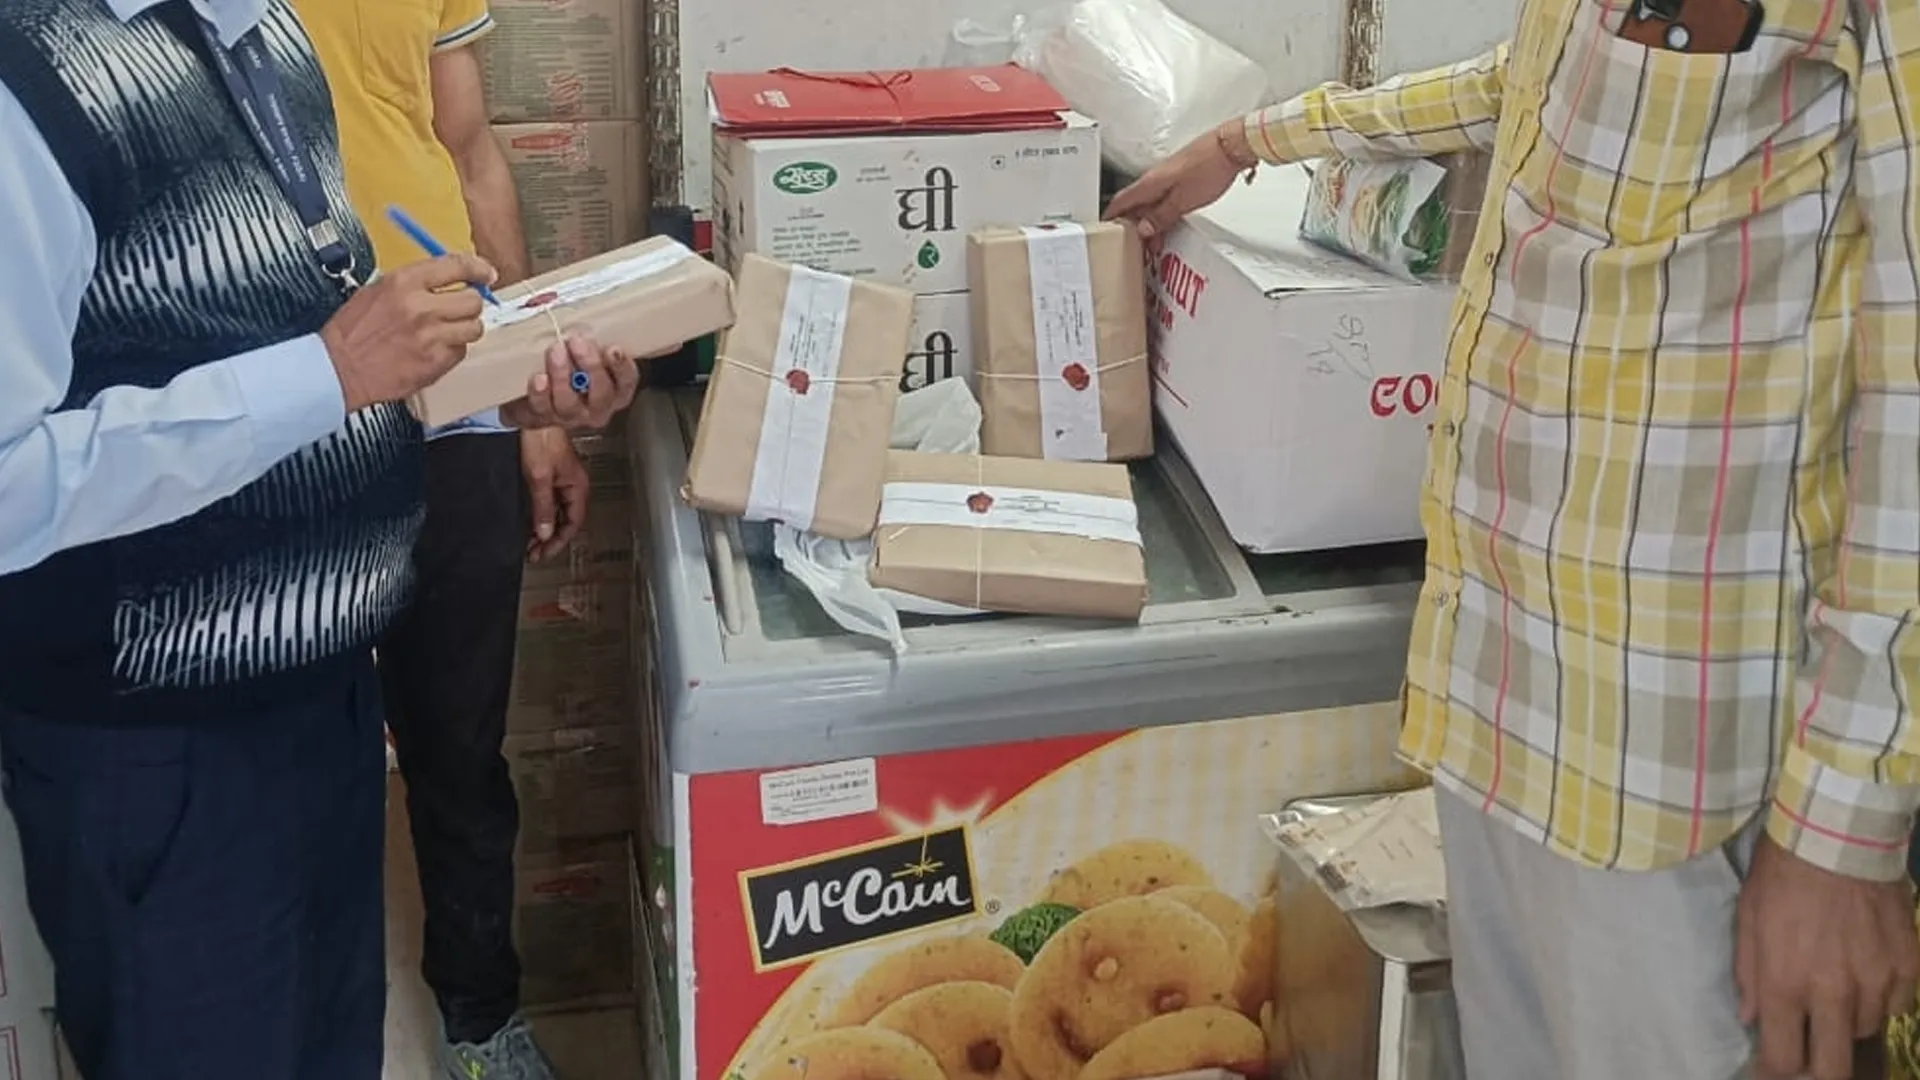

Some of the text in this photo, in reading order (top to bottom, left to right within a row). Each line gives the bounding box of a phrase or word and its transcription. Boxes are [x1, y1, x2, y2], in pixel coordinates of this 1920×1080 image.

[895, 165, 959, 233] घी
[1370, 373, 1440, 417] CO
[763, 866, 971, 950] McCain
